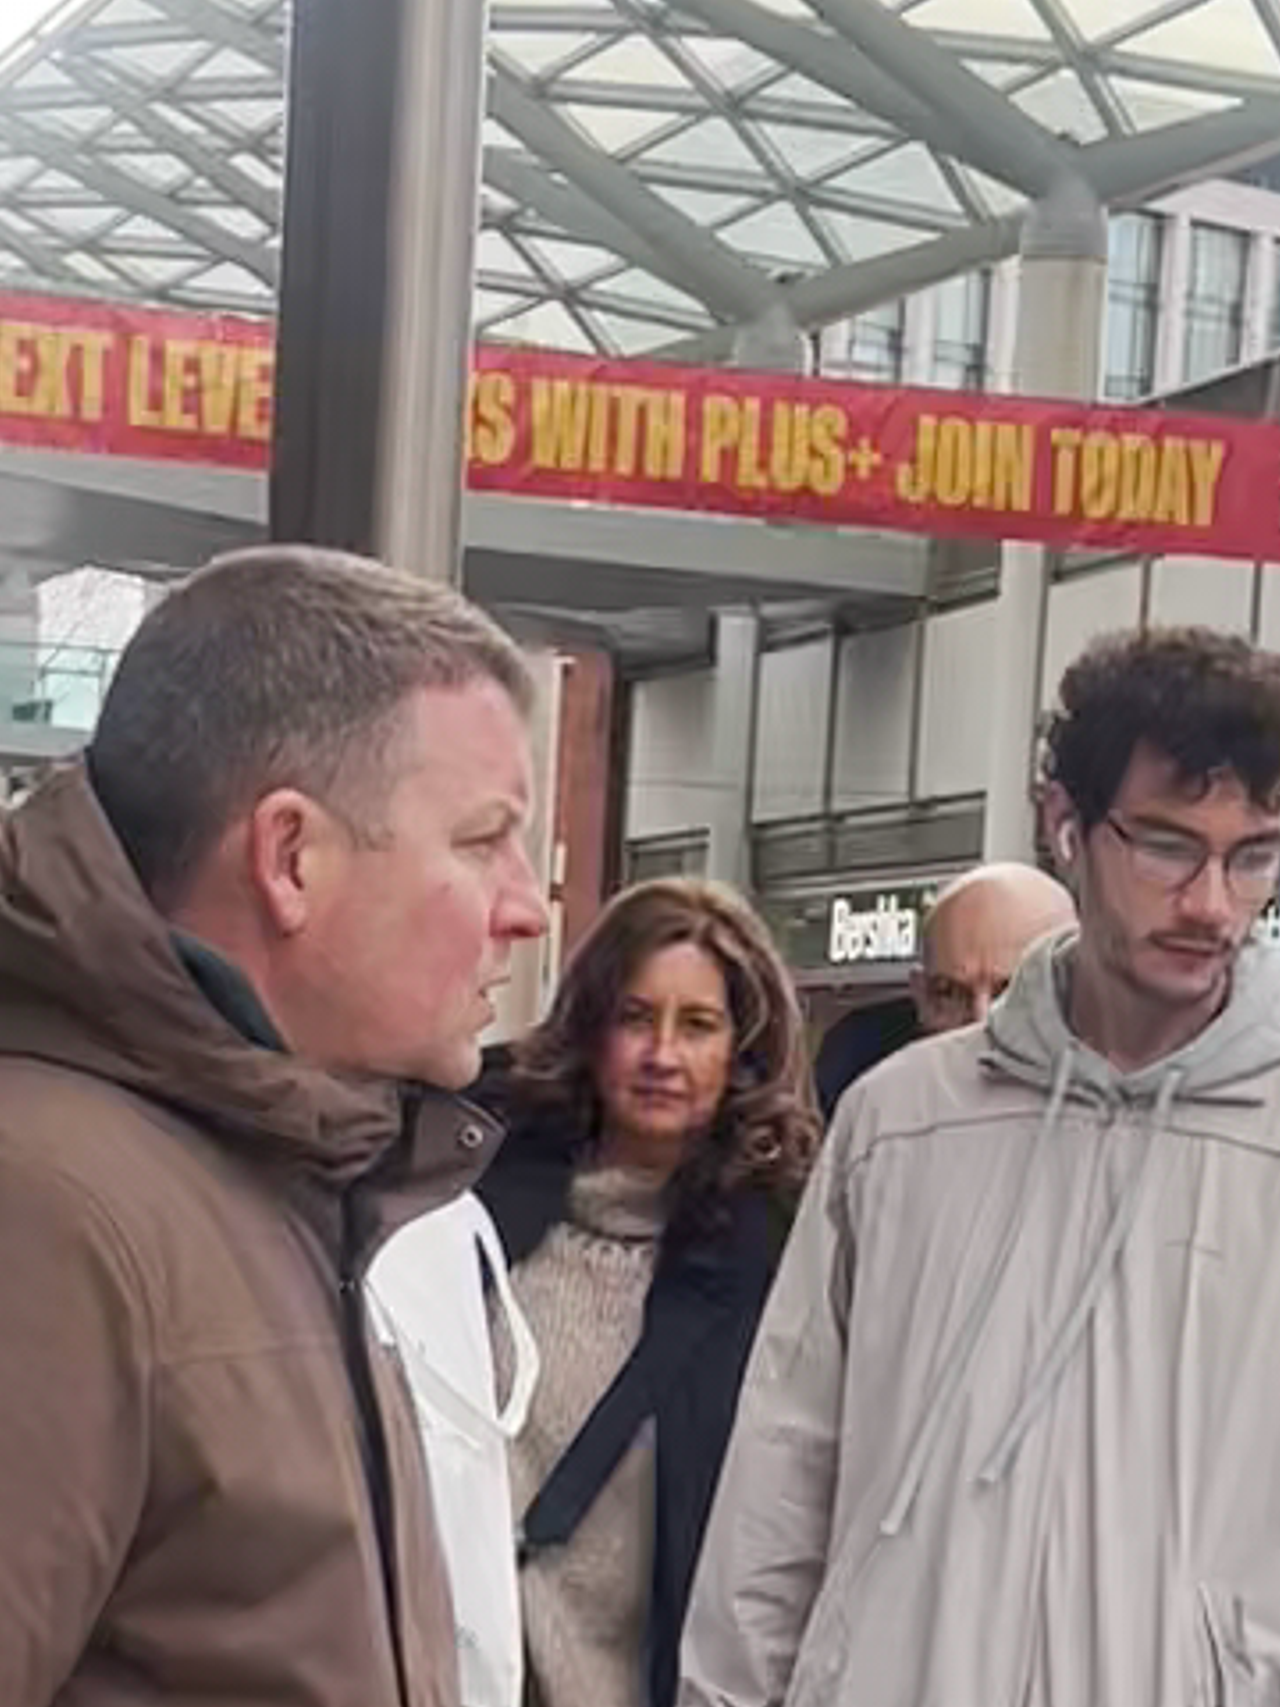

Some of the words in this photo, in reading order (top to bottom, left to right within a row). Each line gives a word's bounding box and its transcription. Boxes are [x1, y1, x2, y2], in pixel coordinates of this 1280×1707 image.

[128, 334, 275, 440] LEVE
[531, 376, 686, 480] WITH
[895, 413, 1033, 512] JOIN
[1050, 427, 1225, 526] TODAY
[828, 895, 918, 962] Bershka
